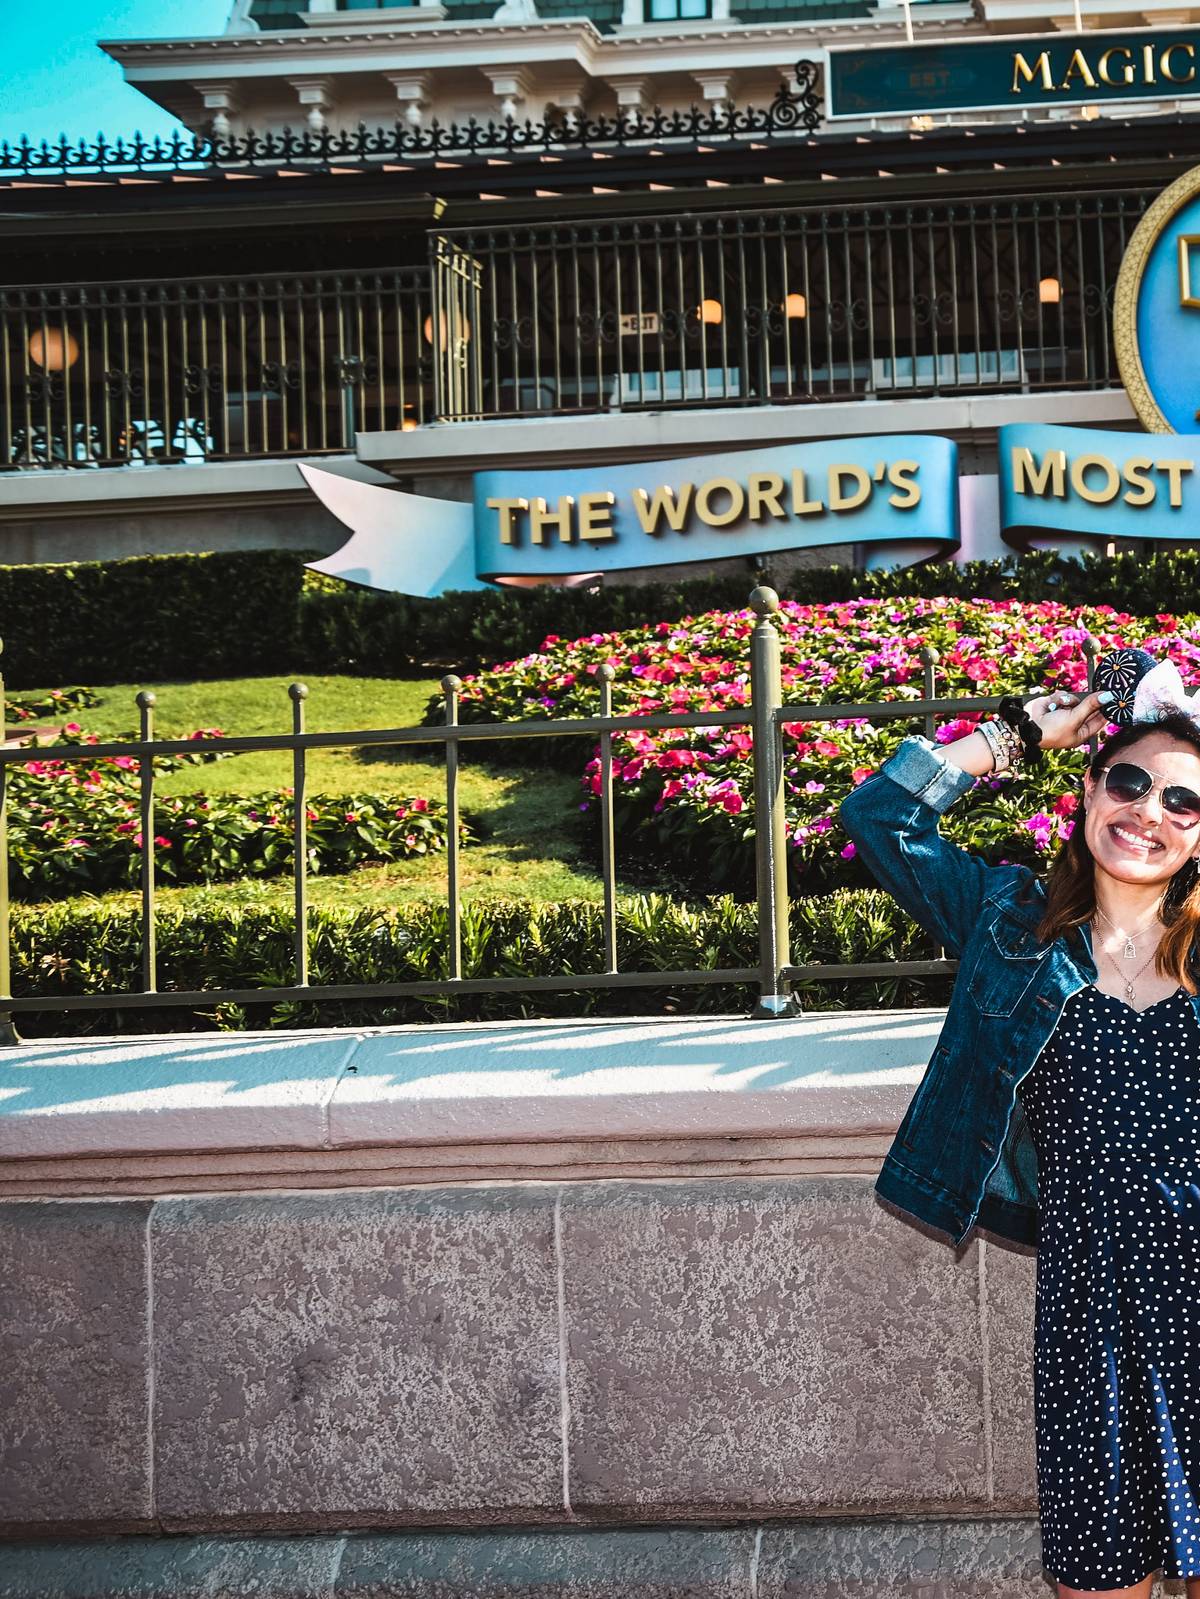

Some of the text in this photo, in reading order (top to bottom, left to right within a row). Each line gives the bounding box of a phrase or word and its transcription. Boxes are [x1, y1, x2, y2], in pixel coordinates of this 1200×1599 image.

[1009, 43, 1195, 93] MAGIC
[487, 490, 615, 545] THE
[632, 461, 921, 535] WORLD'S
[1011, 446, 1194, 507] MOST
